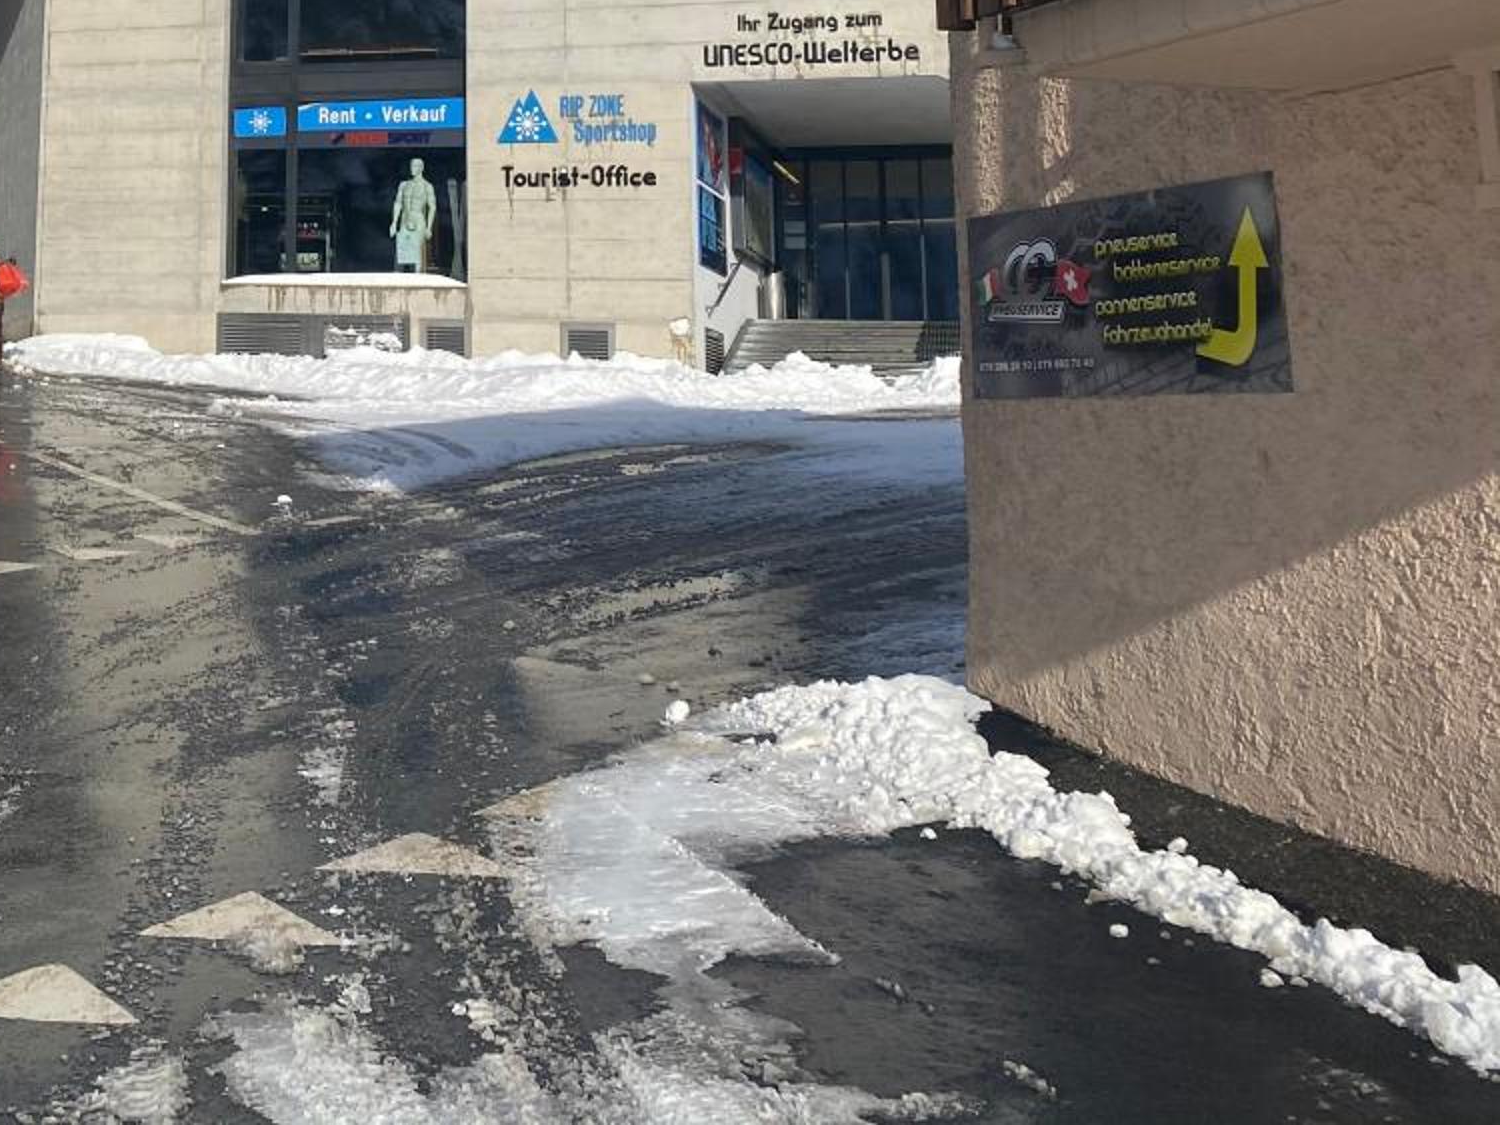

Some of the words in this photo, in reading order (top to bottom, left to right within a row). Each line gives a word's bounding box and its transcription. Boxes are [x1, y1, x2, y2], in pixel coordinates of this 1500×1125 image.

[737, 14, 760, 32] Ihr
[767, 12, 838, 33] Zugang
[845, 13, 883, 27] zum
[703, 39, 920, 67] UNESCO-Welterbe
[318, 106, 356, 124] Rent
[381, 104, 448, 123] Verkauf
[559, 95, 584, 118] RIP
[588, 94, 625, 118] ZONE
[573, 118, 657, 147] Sportshop
[501, 164, 657, 188] Tourist-Office
[1094, 232, 1179, 258] pneuservice
[1095, 290, 1197, 317] pannenservice
